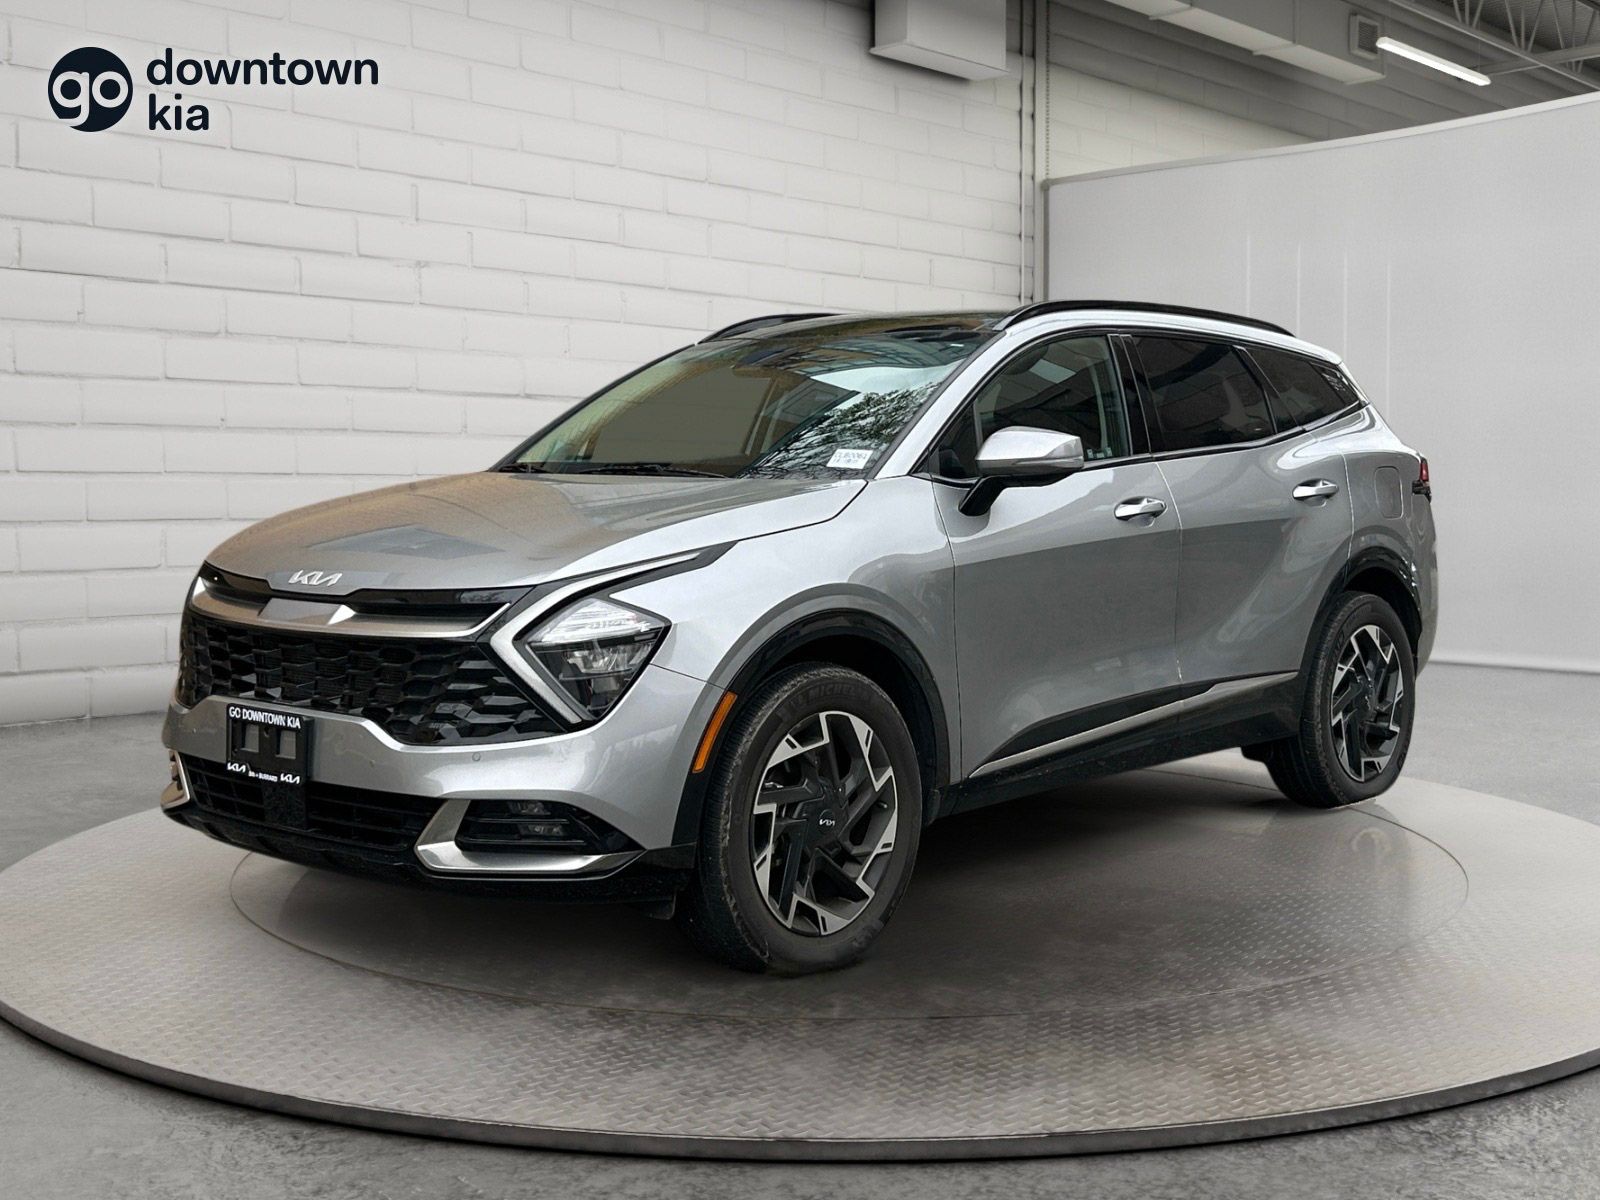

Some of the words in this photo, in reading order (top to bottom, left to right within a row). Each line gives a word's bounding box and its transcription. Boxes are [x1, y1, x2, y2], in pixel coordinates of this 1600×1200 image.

[288, 570, 343, 587] KIA
[229, 706, 241, 718] GO
[242, 708, 286, 726] DOWNTOWN
[287, 716, 301, 729] KIA
[227, 762, 246, 773] KIA
[280, 773, 300, 785] KIA
